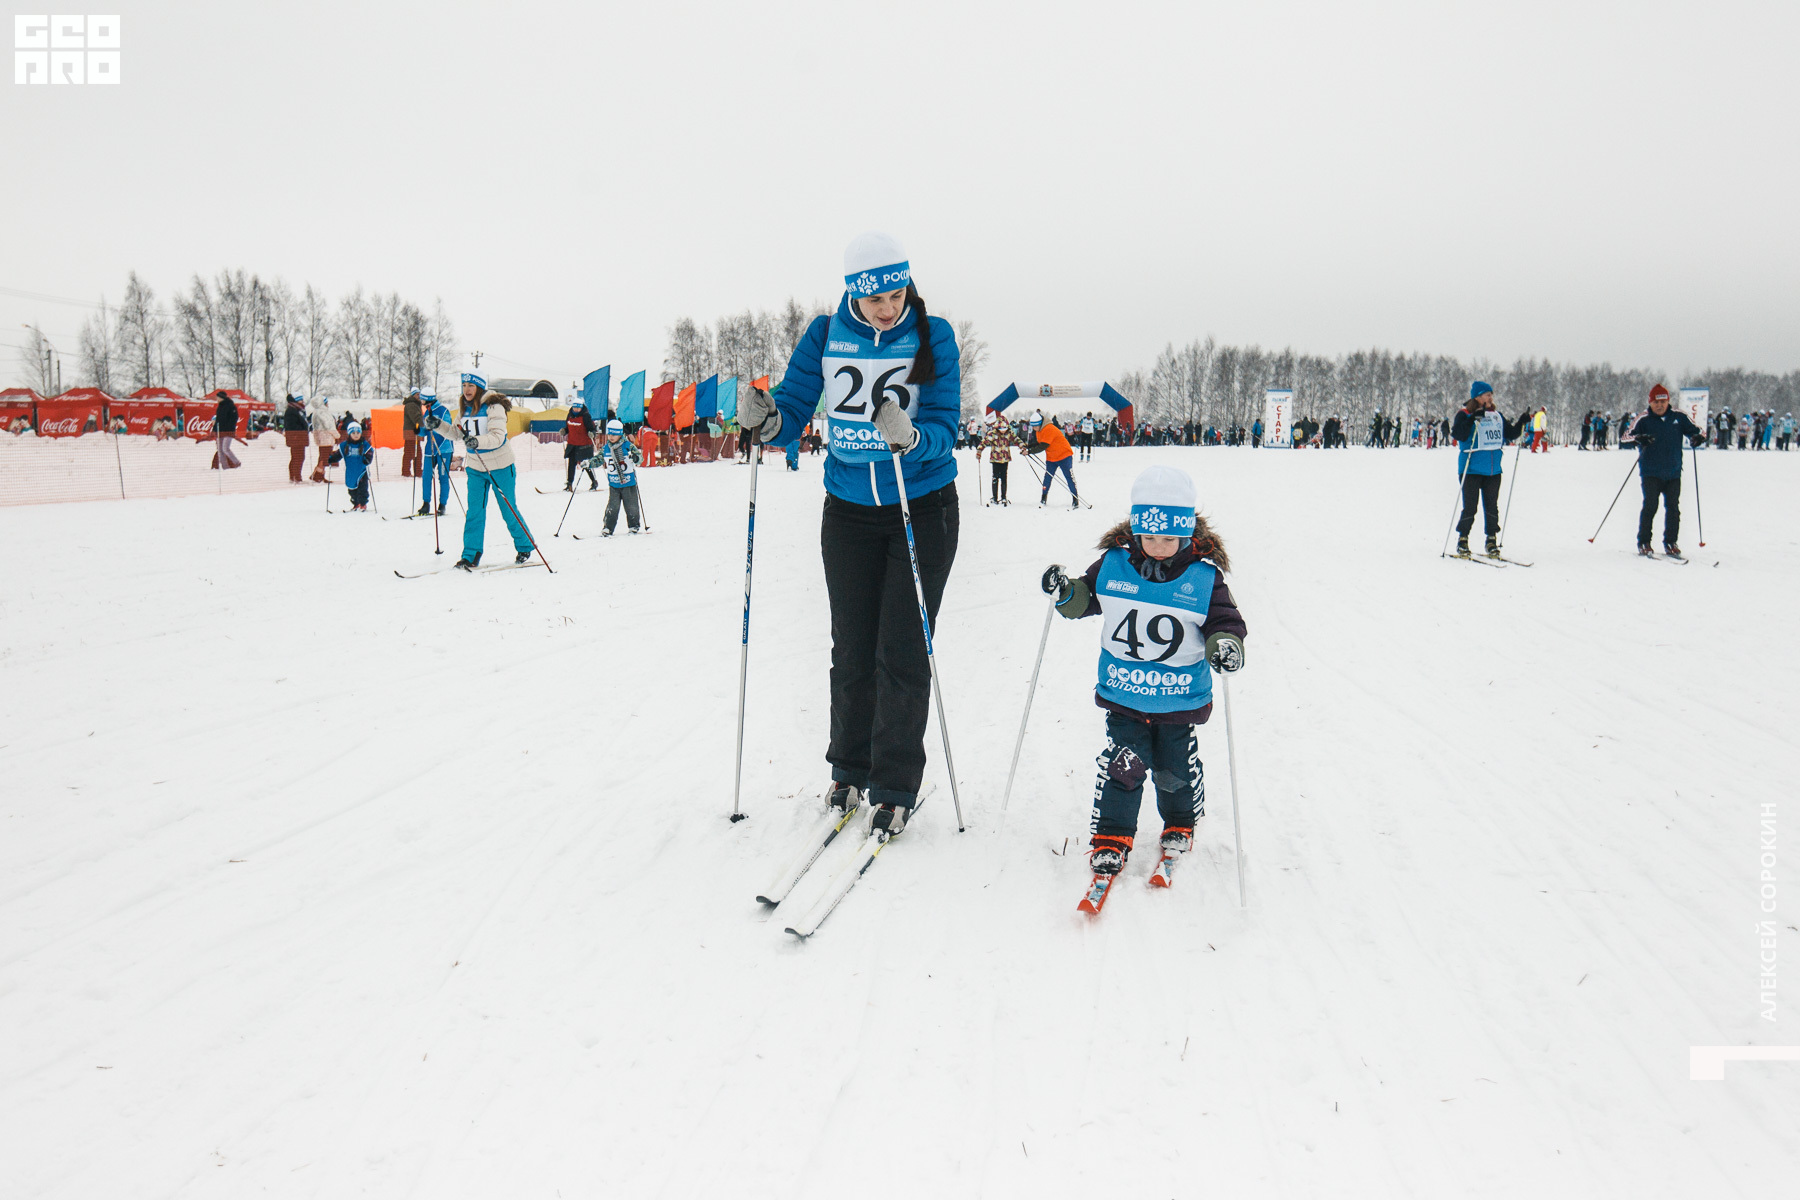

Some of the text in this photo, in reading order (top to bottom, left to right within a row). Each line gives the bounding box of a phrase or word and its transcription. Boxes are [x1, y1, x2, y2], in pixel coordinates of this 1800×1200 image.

[833, 365, 911, 415] 26
[833, 439, 885, 450] OUTDOOR
[1106, 580, 1140, 594] World Class
[1111, 608, 1185, 662] 49
[1106, 678, 1190, 696] OUTDOOR TEAM
